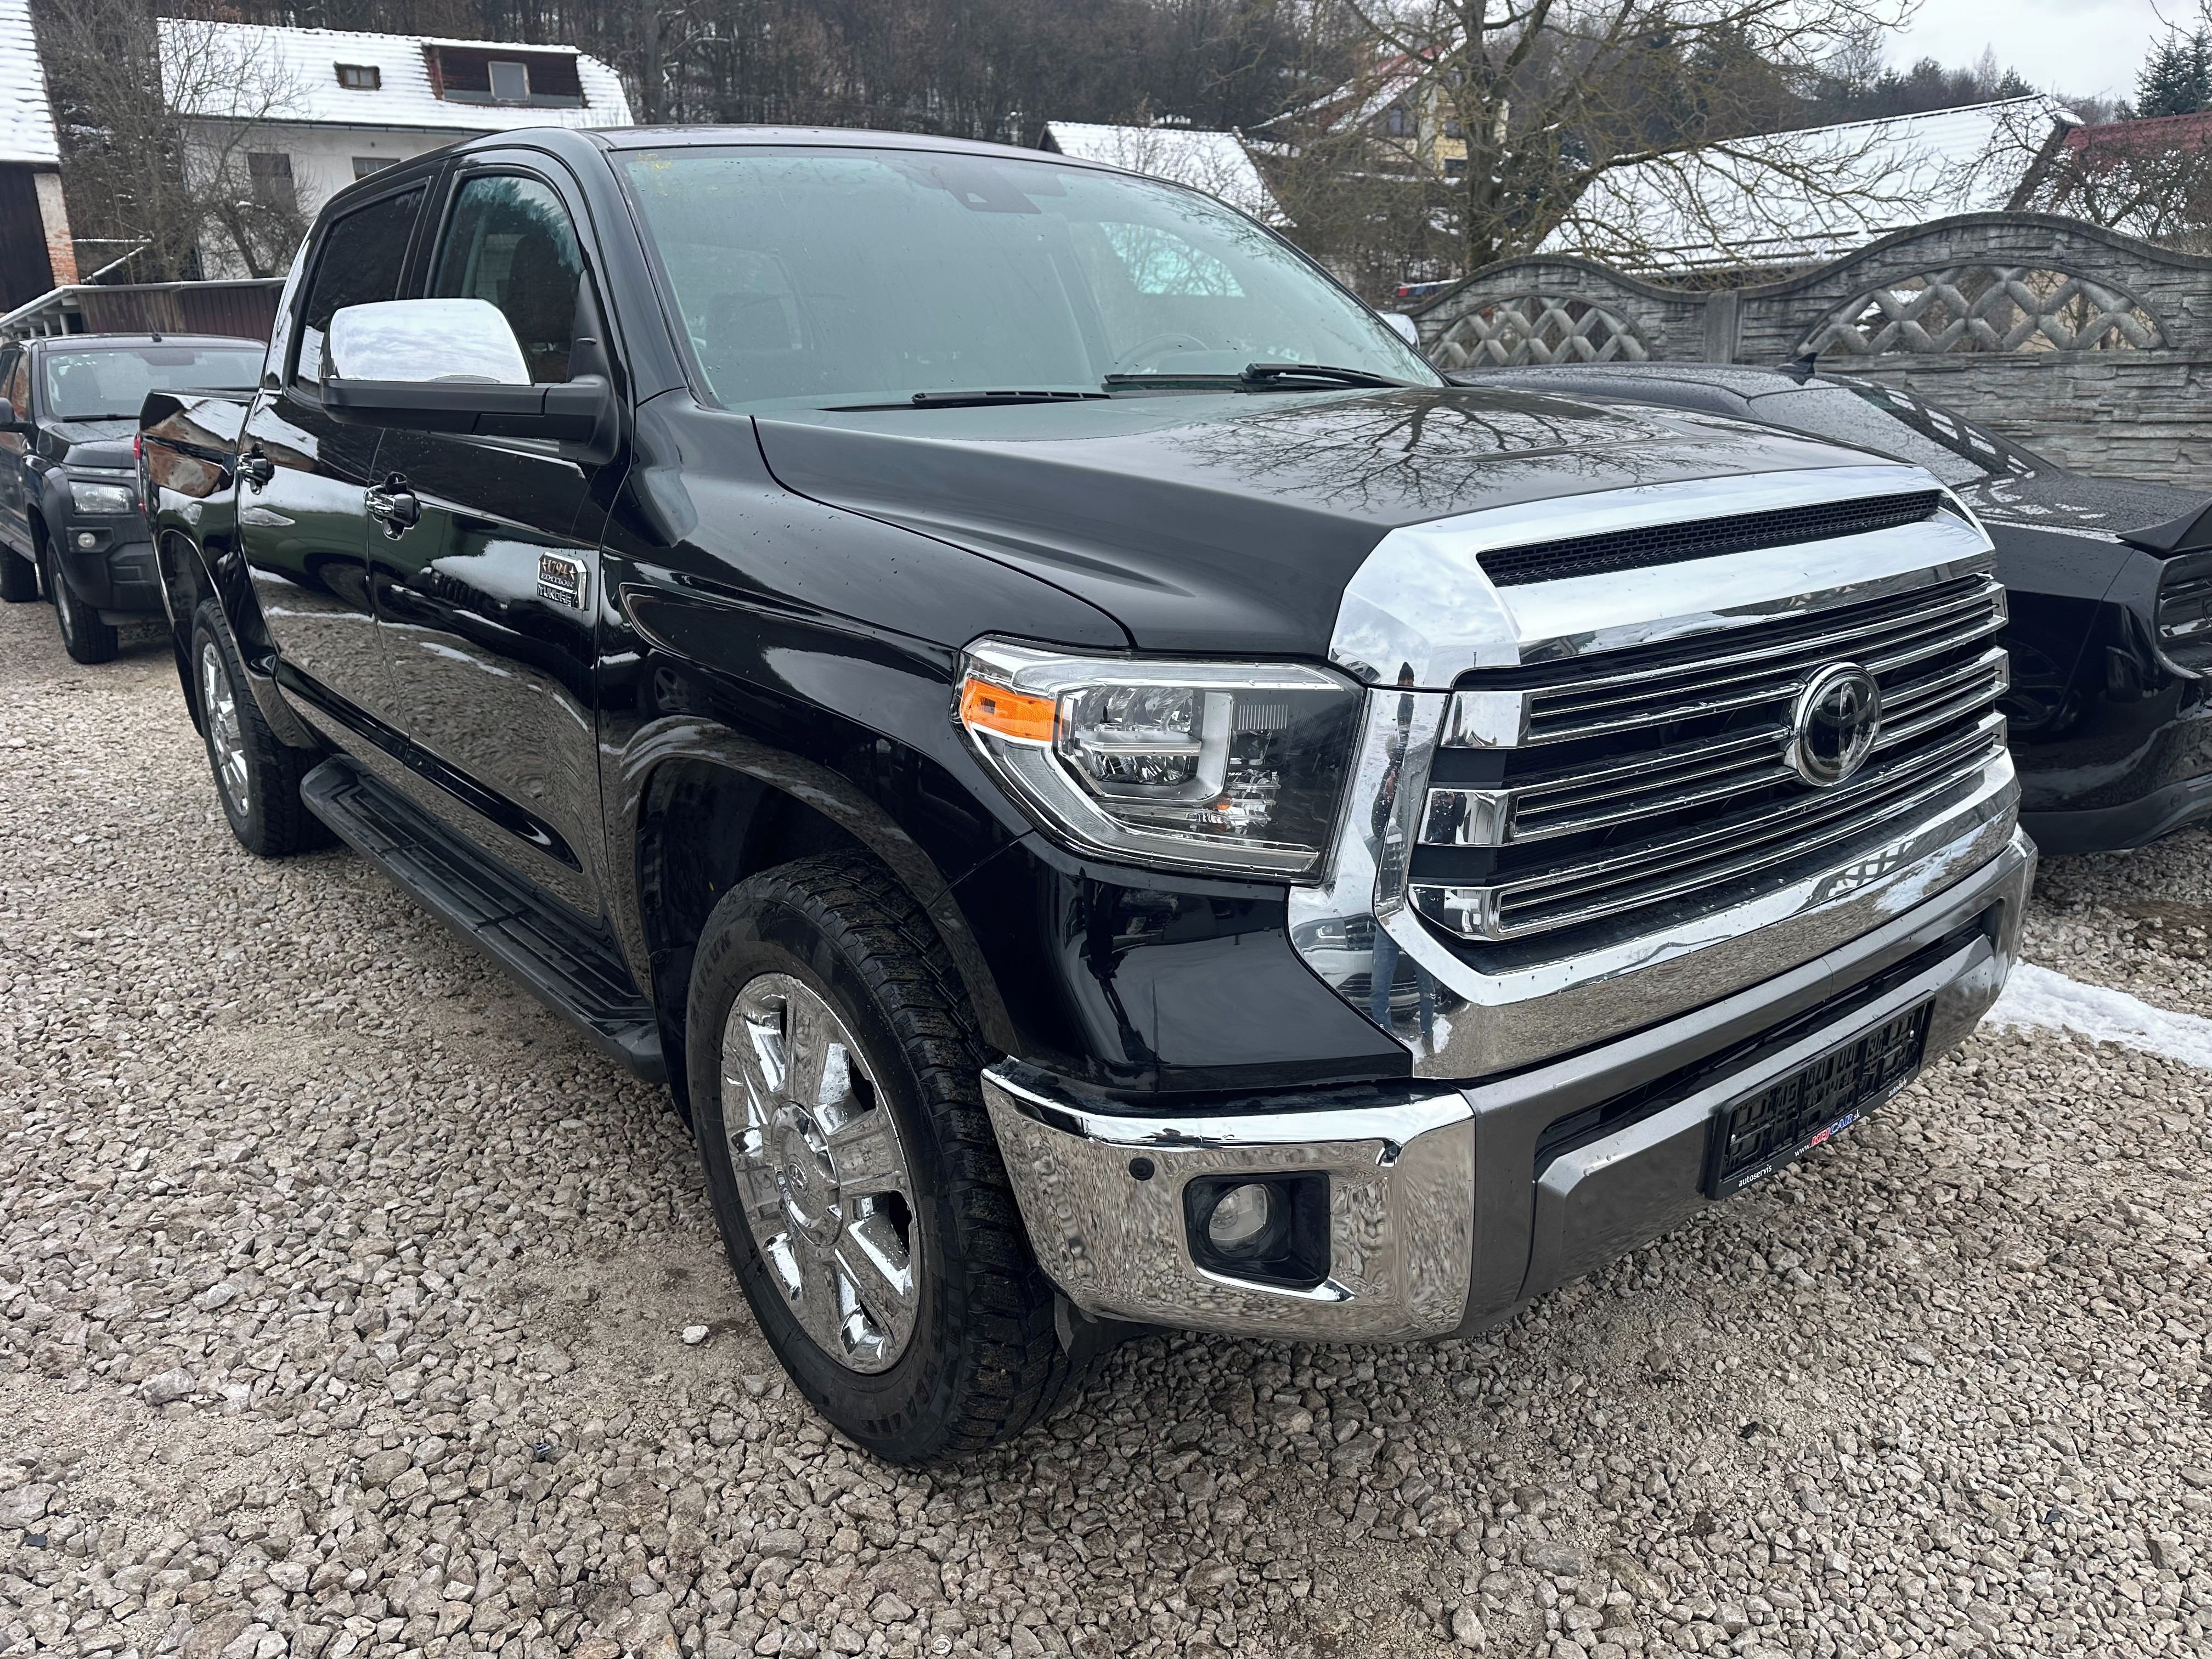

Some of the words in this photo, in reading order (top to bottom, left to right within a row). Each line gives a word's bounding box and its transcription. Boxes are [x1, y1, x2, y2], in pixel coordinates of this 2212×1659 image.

[548, 560, 568, 575] 1794
[541, 572, 574, 588] EDITION
[1738, 1164, 1772, 1187] autoservis
[1888, 1076, 1908, 1097] autodiely
